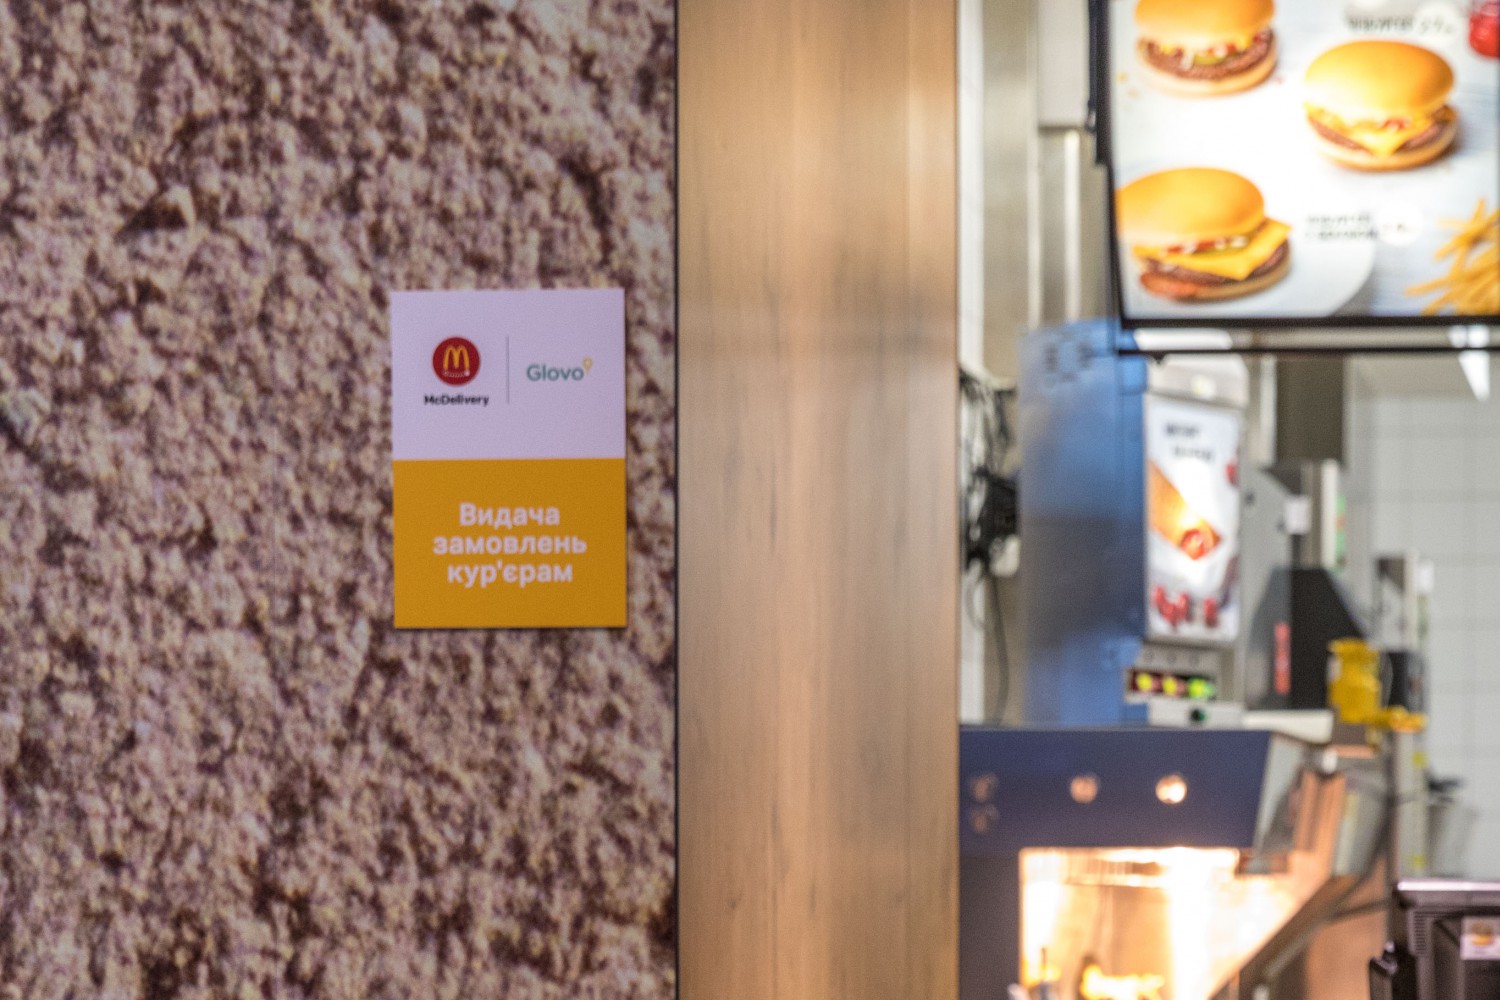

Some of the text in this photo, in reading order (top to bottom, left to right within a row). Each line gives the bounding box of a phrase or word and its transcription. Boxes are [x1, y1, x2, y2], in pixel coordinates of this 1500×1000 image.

[526, 364, 584, 382] Glovo
[424, 394, 489, 406] McDelivery
[459, 502, 560, 529] Видача
[433, 535, 588, 555] замовлень
[447, 559, 573, 588] кур'єрам
